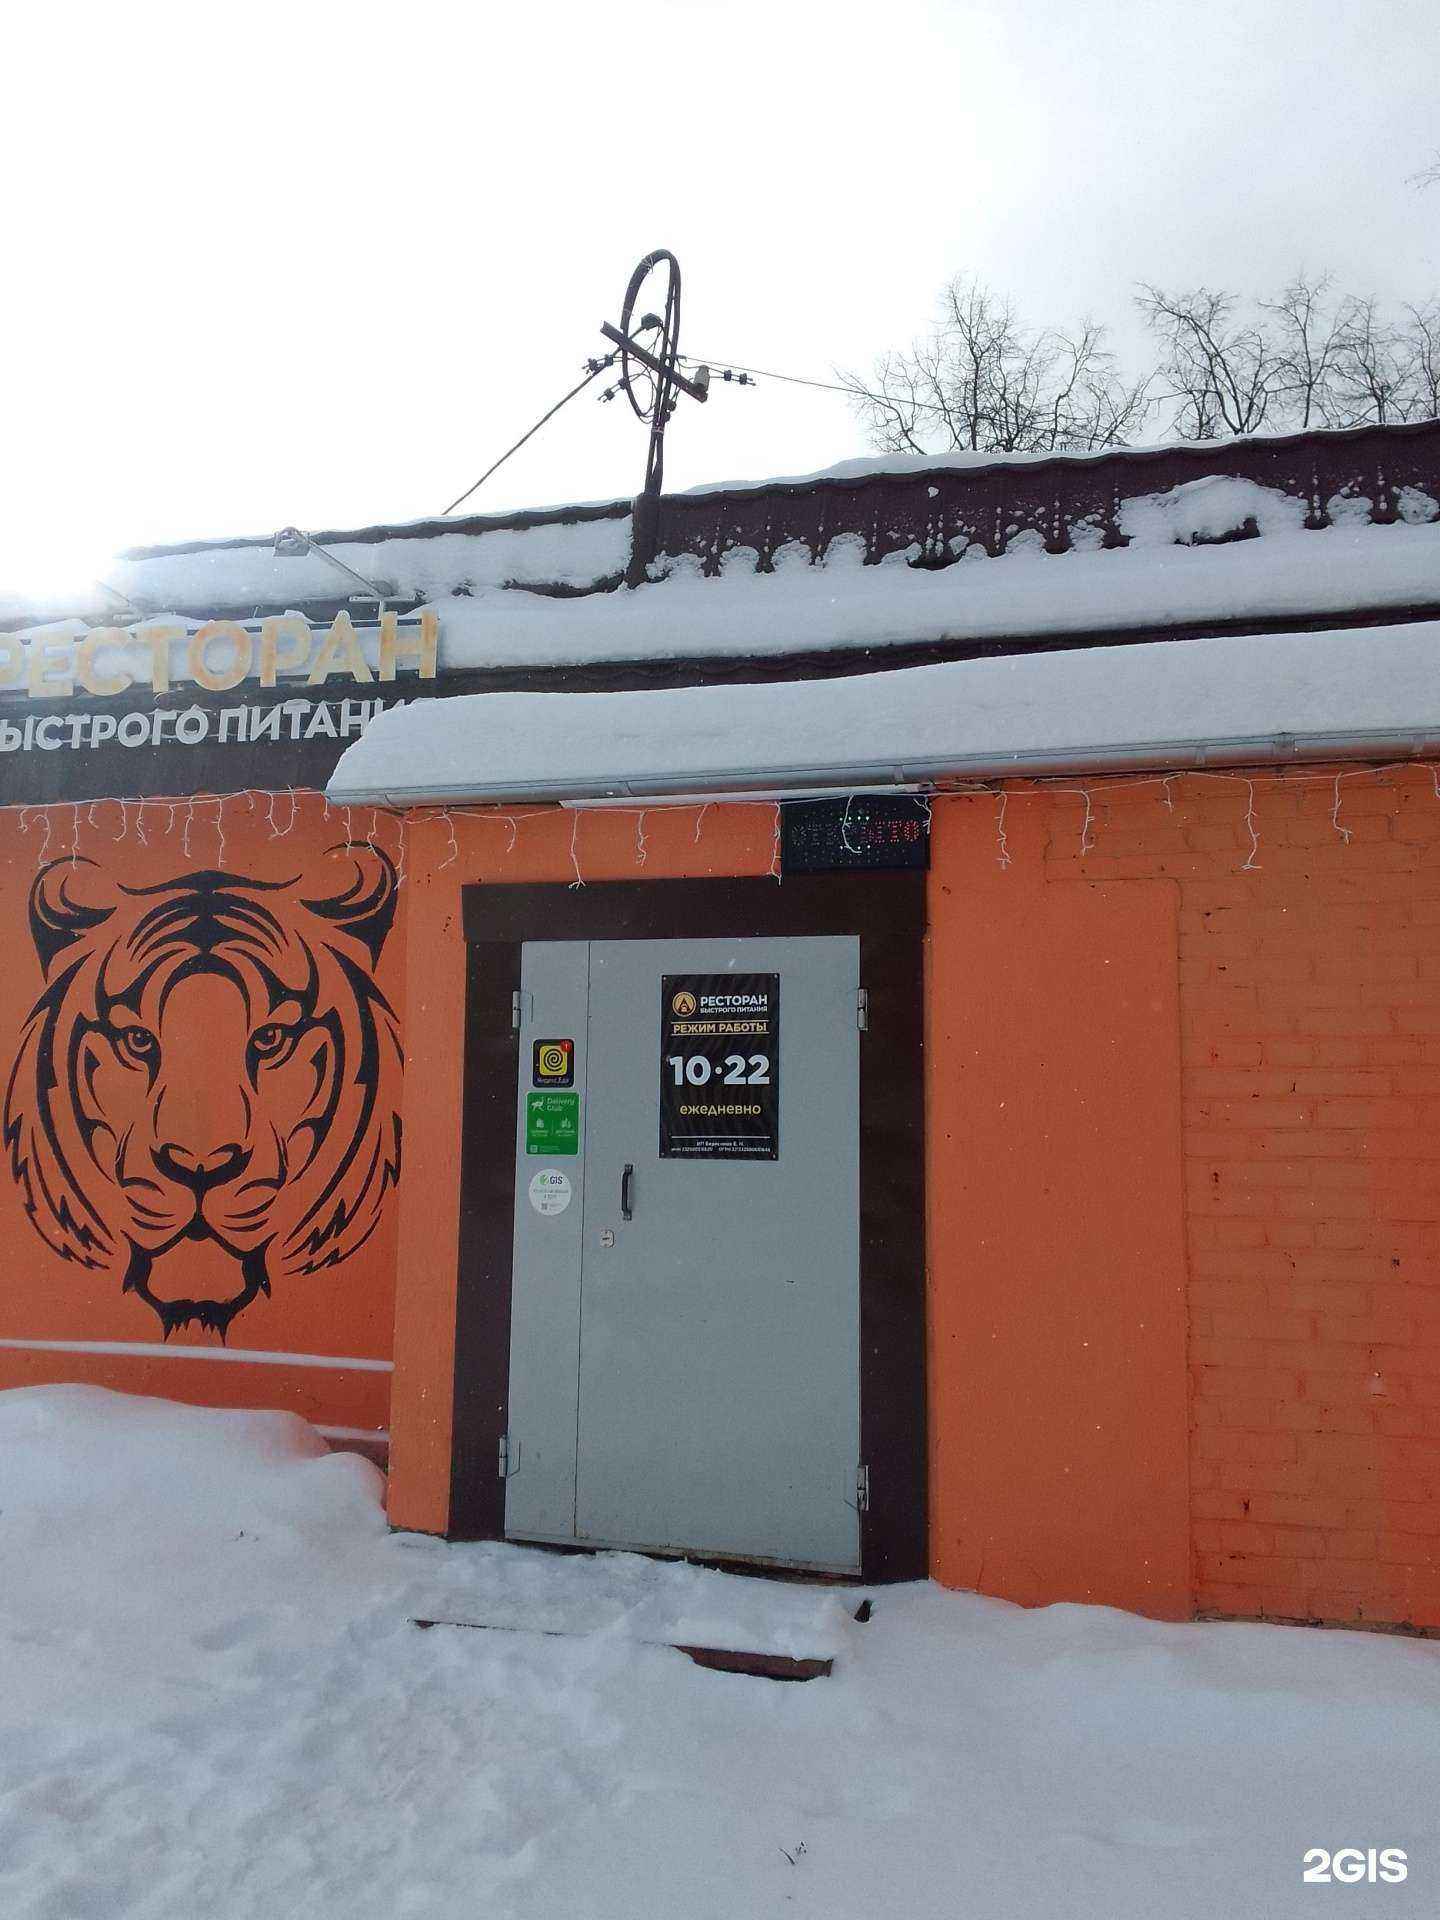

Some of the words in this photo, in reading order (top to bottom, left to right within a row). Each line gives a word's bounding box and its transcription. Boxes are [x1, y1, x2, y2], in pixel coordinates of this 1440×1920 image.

[700, 994, 768, 1007] РЕСТОРАН
[737, 1005, 768, 1013] ПИТАНИЯ
[673, 1023, 716, 1034] РЕЖИМ
[718, 1022, 767, 1033] РАБОТЫ
[680, 1104, 761, 1117] ежедневно
